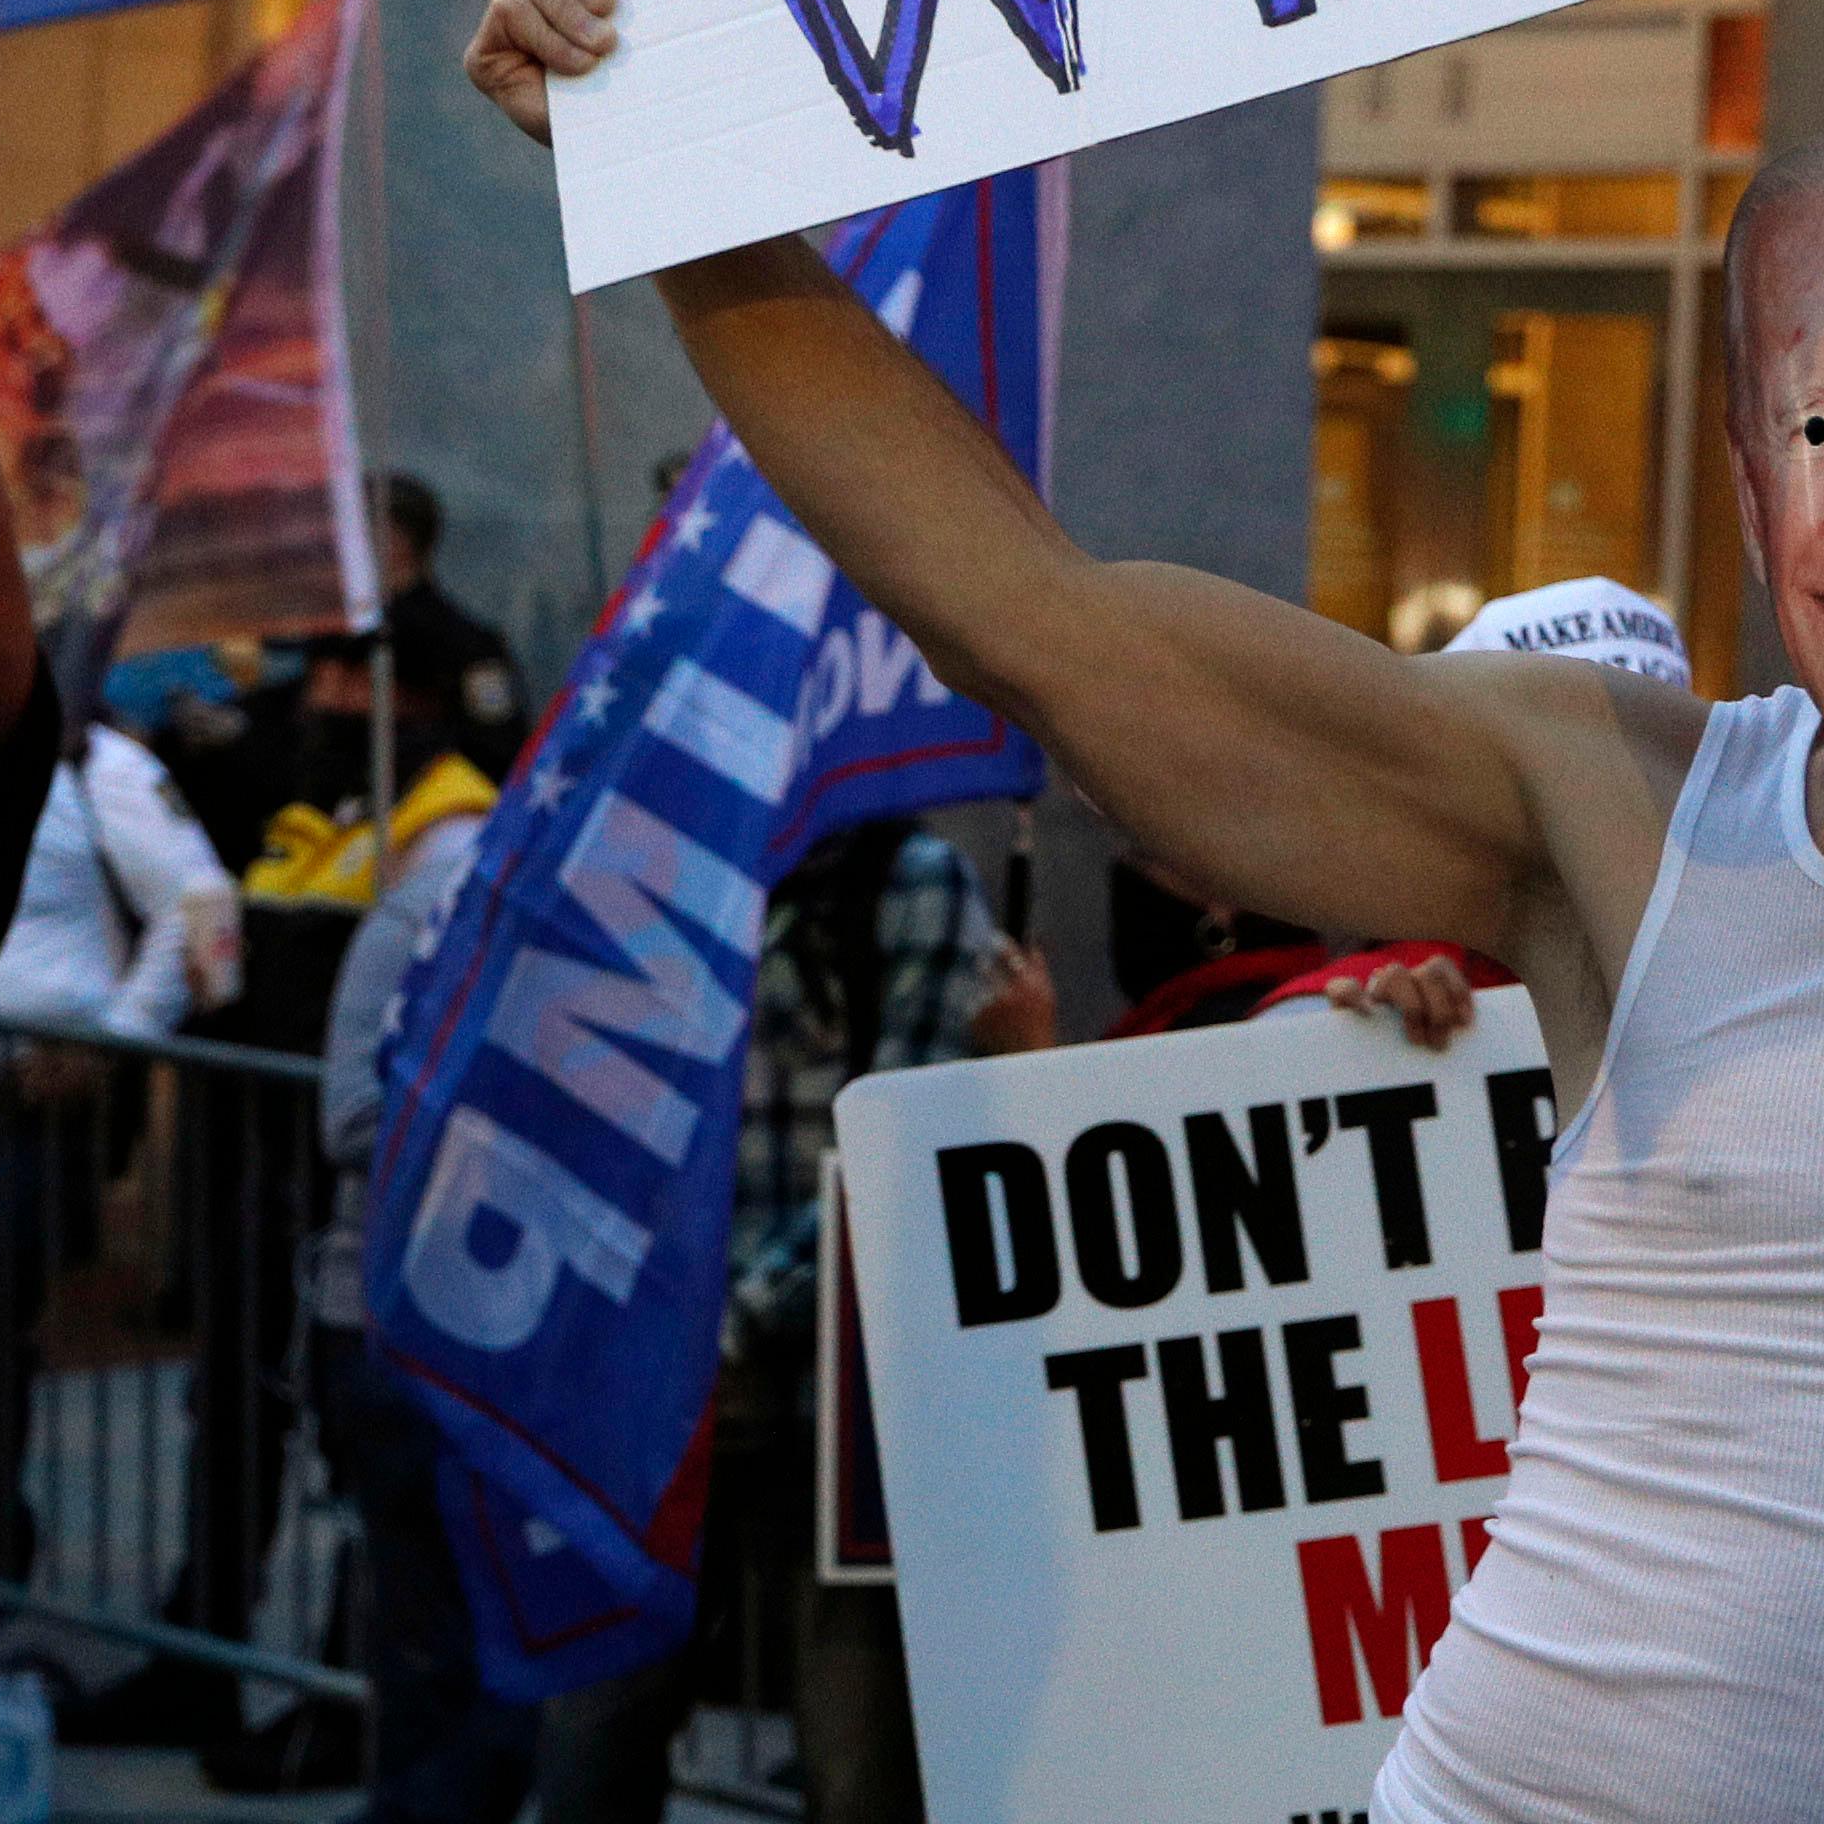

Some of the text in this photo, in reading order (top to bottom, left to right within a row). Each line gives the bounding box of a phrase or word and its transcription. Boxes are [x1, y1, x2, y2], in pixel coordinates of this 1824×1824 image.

[1503, 608, 1597, 653] MAKE
[936, 1082, 1439, 1331] DON'T
[1045, 1314, 1387, 1532] THE
[1297, 1517, 1494, 1728] M
